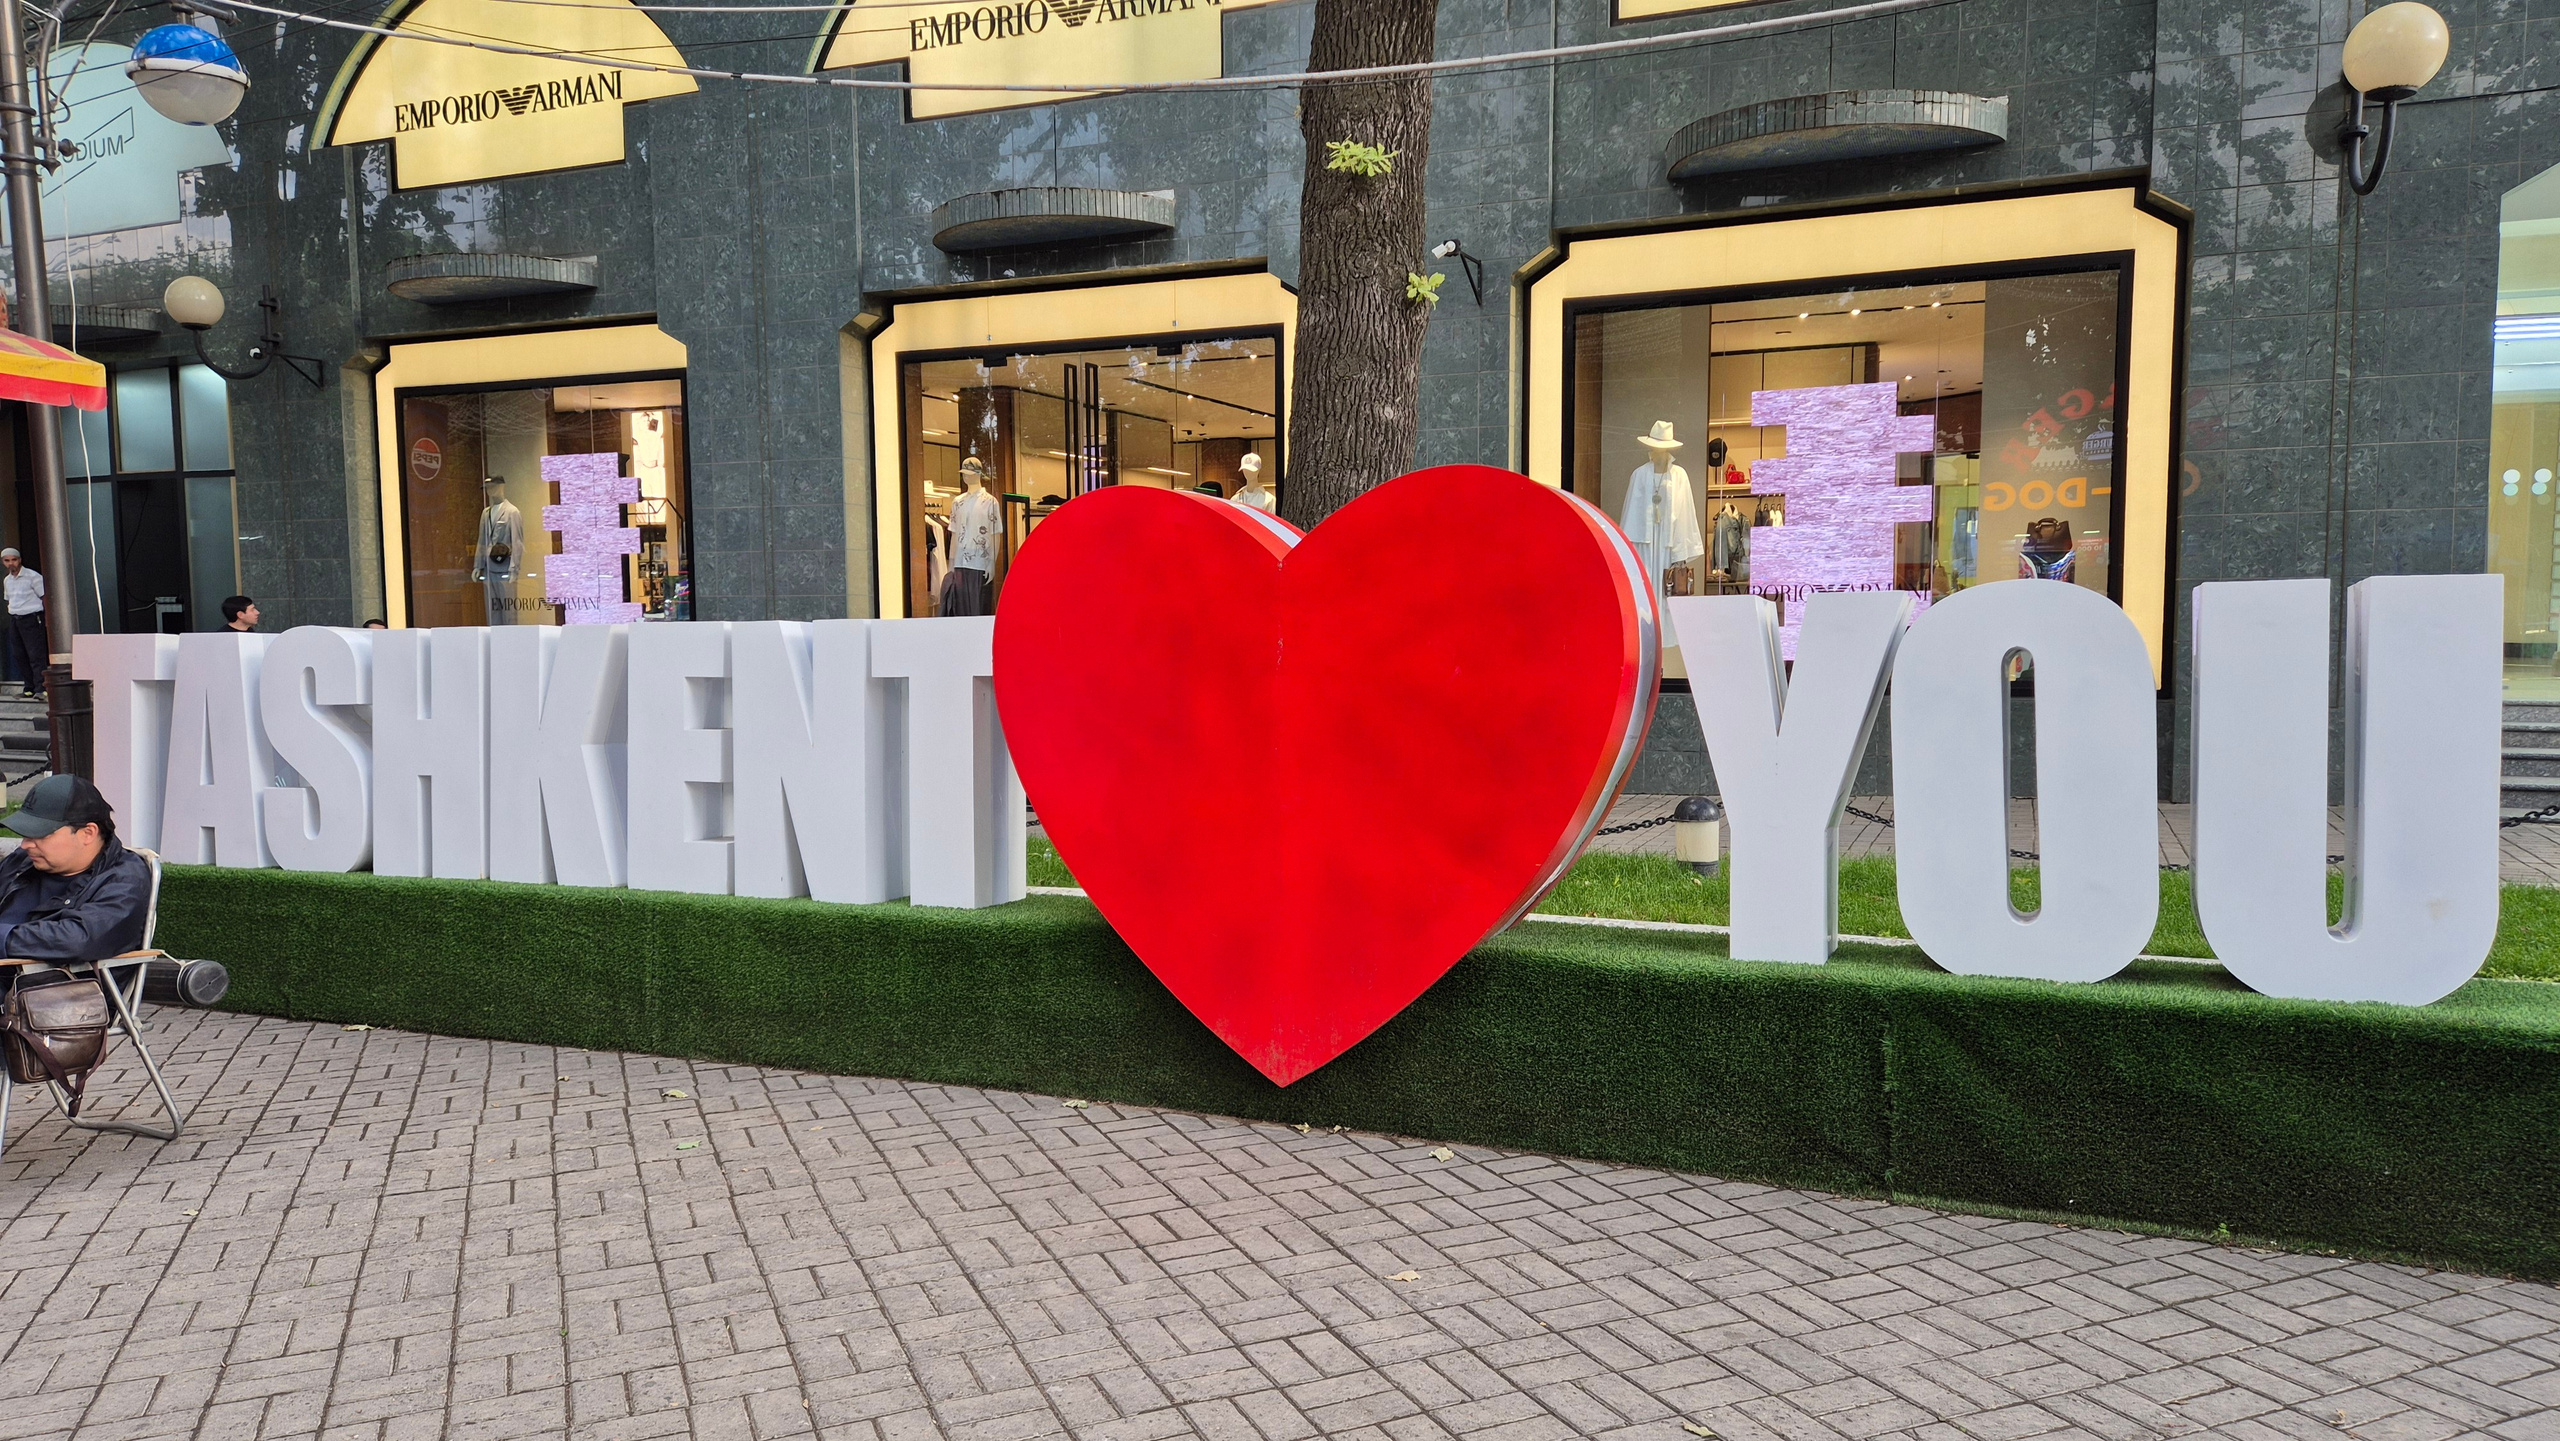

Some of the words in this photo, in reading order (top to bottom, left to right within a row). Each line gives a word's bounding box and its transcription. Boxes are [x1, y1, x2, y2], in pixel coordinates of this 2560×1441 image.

[908, 0, 1049, 52] EMPORIO
[395, 90, 500, 133] EMPORIO
[532, 70, 623, 113] ARMANI
[57, 135, 124, 164] DIUM
[491, 597, 540, 611] EMPORIO
[72, 618, 1027, 909] TASHKENT
[1668, 574, 2504, 1007] YOU
